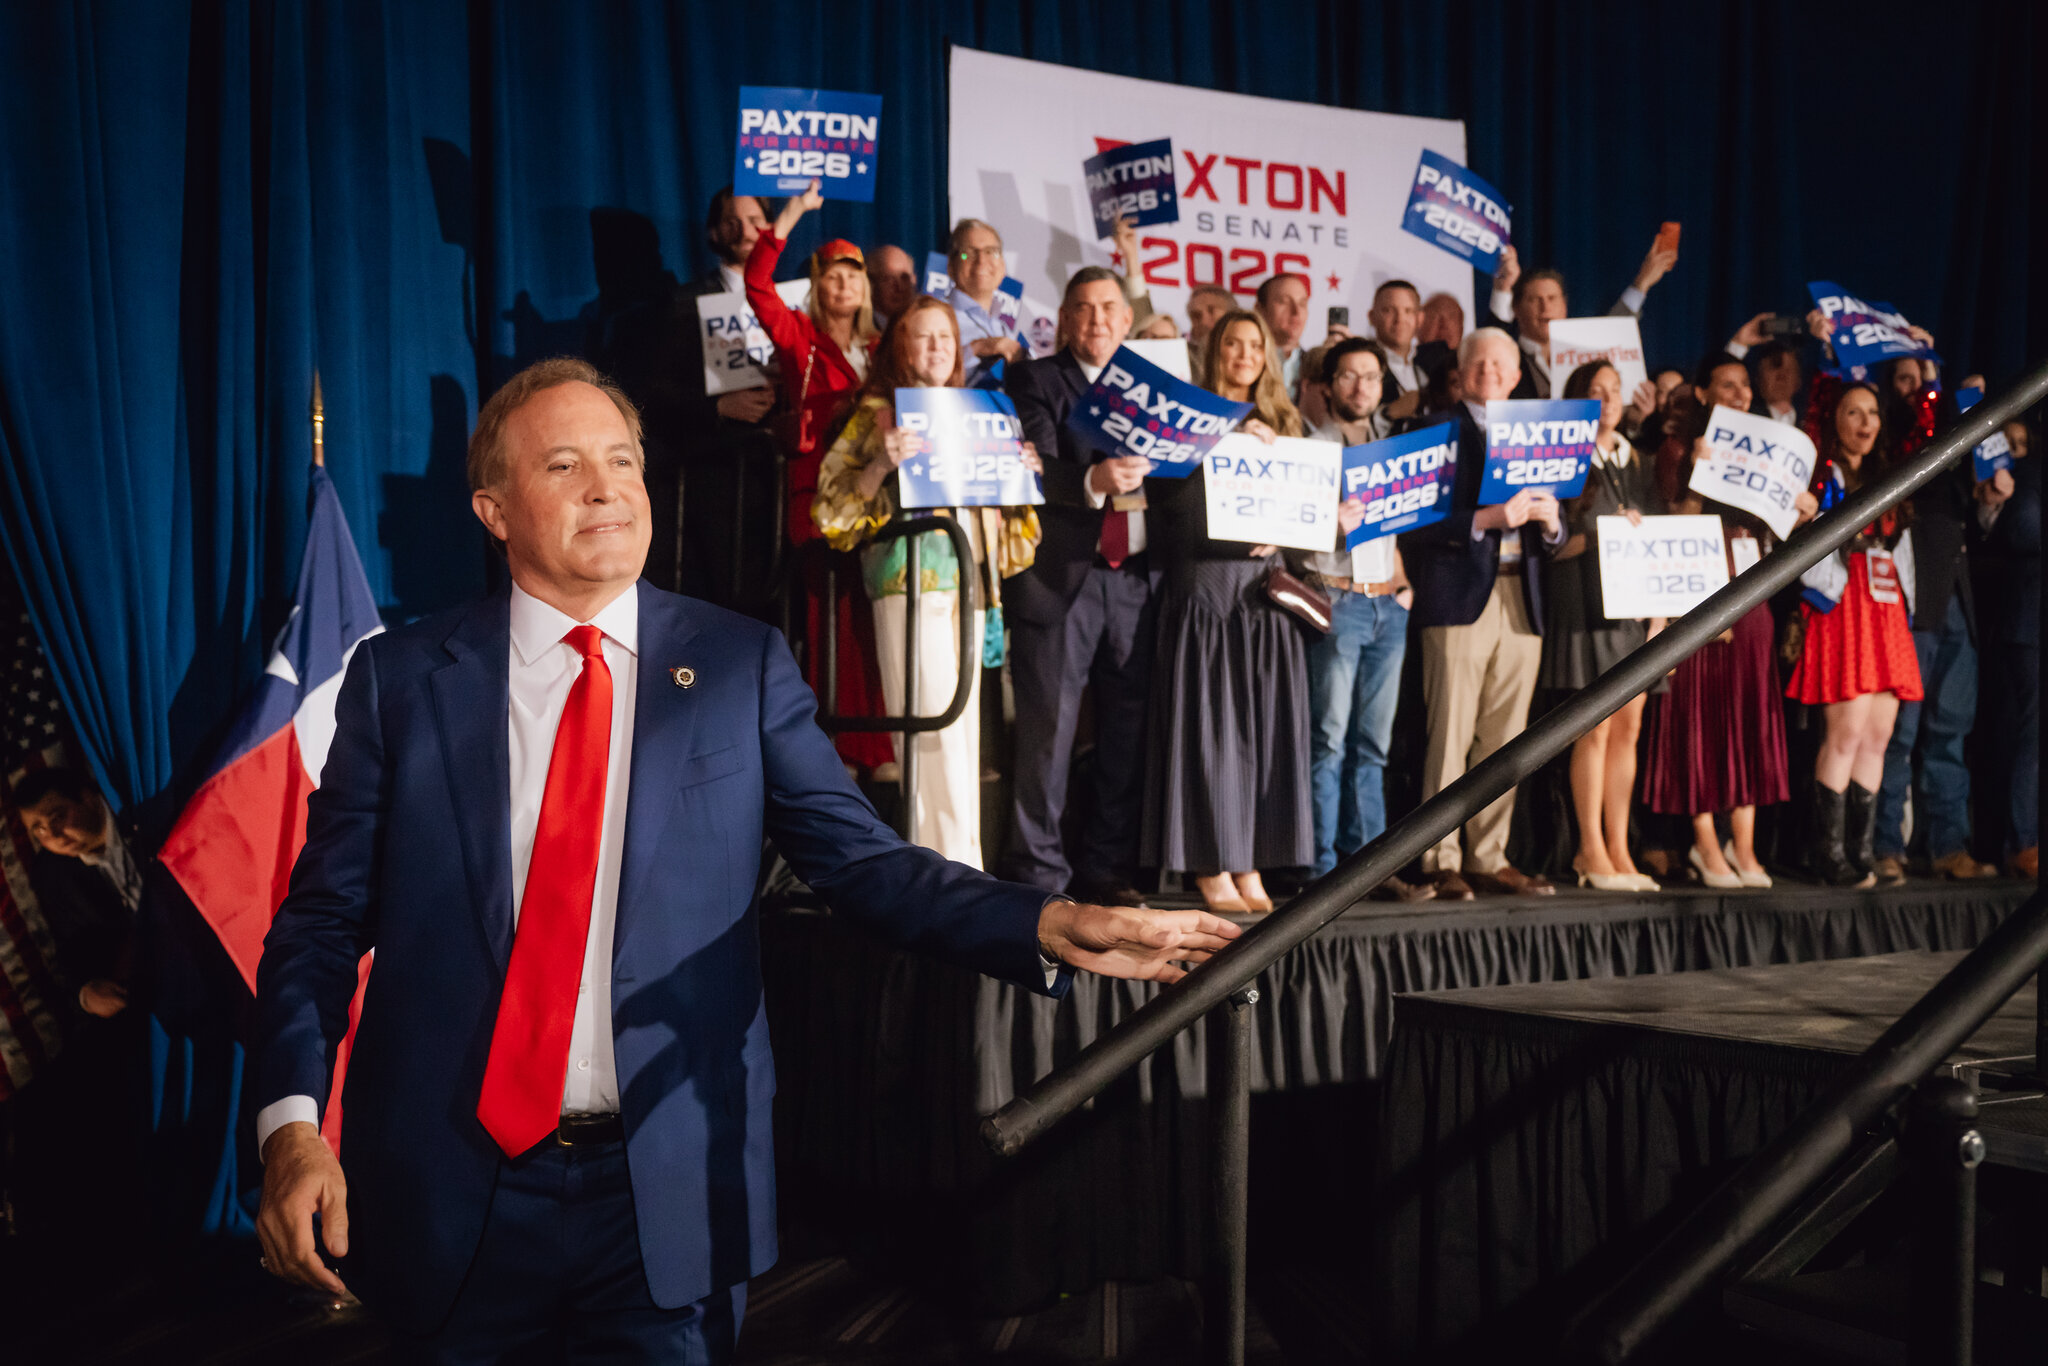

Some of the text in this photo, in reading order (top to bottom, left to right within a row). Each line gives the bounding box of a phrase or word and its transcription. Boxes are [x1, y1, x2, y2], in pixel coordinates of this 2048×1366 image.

[741, 108, 878, 142] PAXTON
[757, 149, 852, 179] 2026
[1094, 137, 1347, 217] XTON
[1417, 164, 1511, 236] PAXTON
[1196, 211, 1349, 249] SENATE
[1424, 203, 1501, 255] 2026
[1140, 236, 1312, 299] 2026
[1101, 362, 1239, 438] PAXTON
[1101, 410, 1196, 464] 2026
[1490, 419, 1599, 447] PAXTON
[1211, 455, 1336, 488] PAXTON
[1344, 440, 1459, 493] PAXTON
[1505, 457, 1578, 485] 2026
[1364, 481, 1440, 525] 2026
[1722, 464, 1793, 511] 2026
[1235, 496, 1318, 525] 206
[1604, 538, 1721, 560] PAXTON
[1645, 573, 1706, 595] 026
